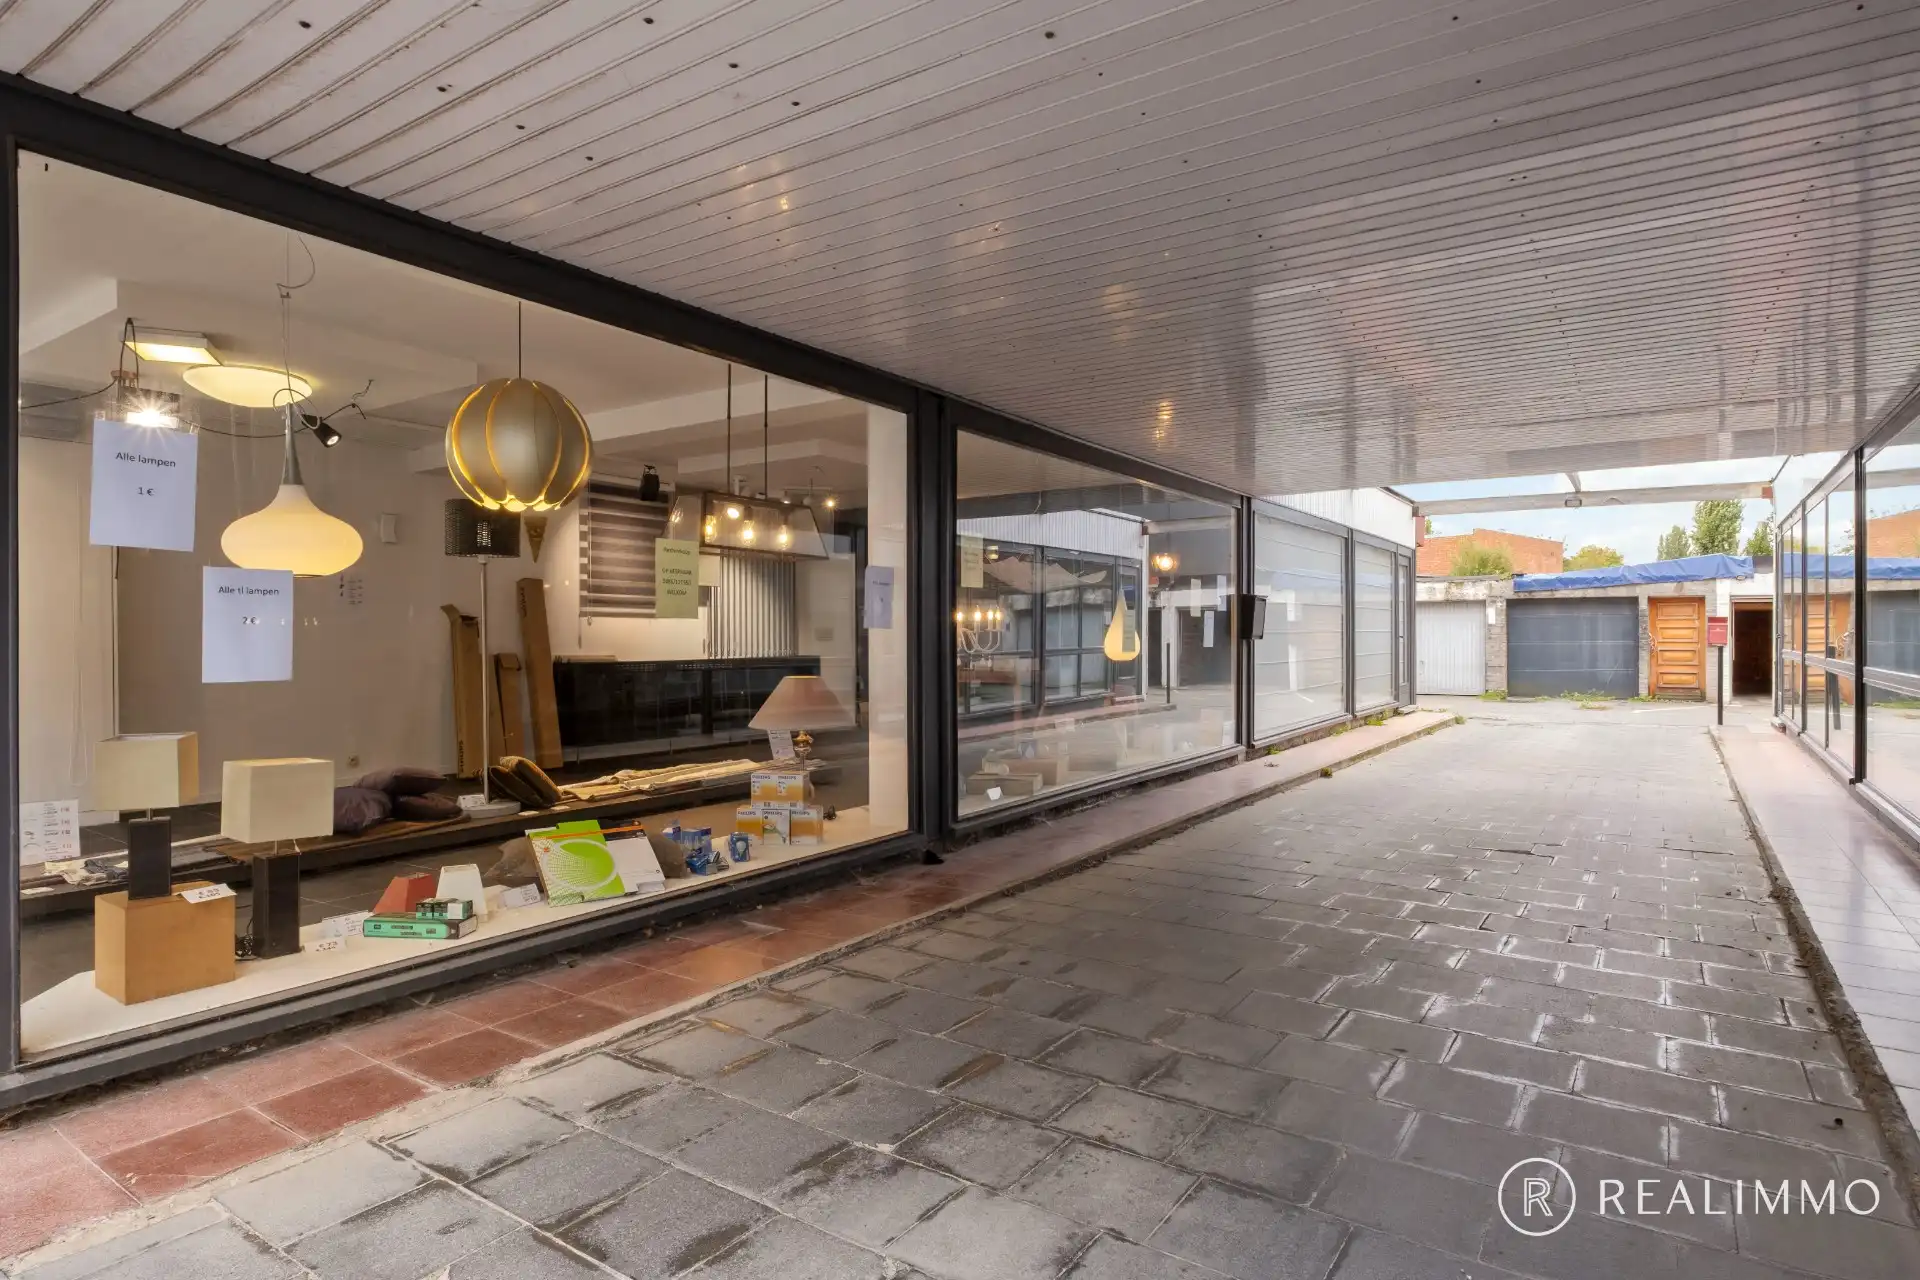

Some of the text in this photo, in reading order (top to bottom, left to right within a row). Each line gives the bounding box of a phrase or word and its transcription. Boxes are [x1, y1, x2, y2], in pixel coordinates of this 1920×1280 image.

[115, 452, 176, 468] Alle lampen
[138, 486, 155, 496] 1 €
[218, 586, 280, 596] Alle tl lampen
[242, 616, 248, 625] 2
